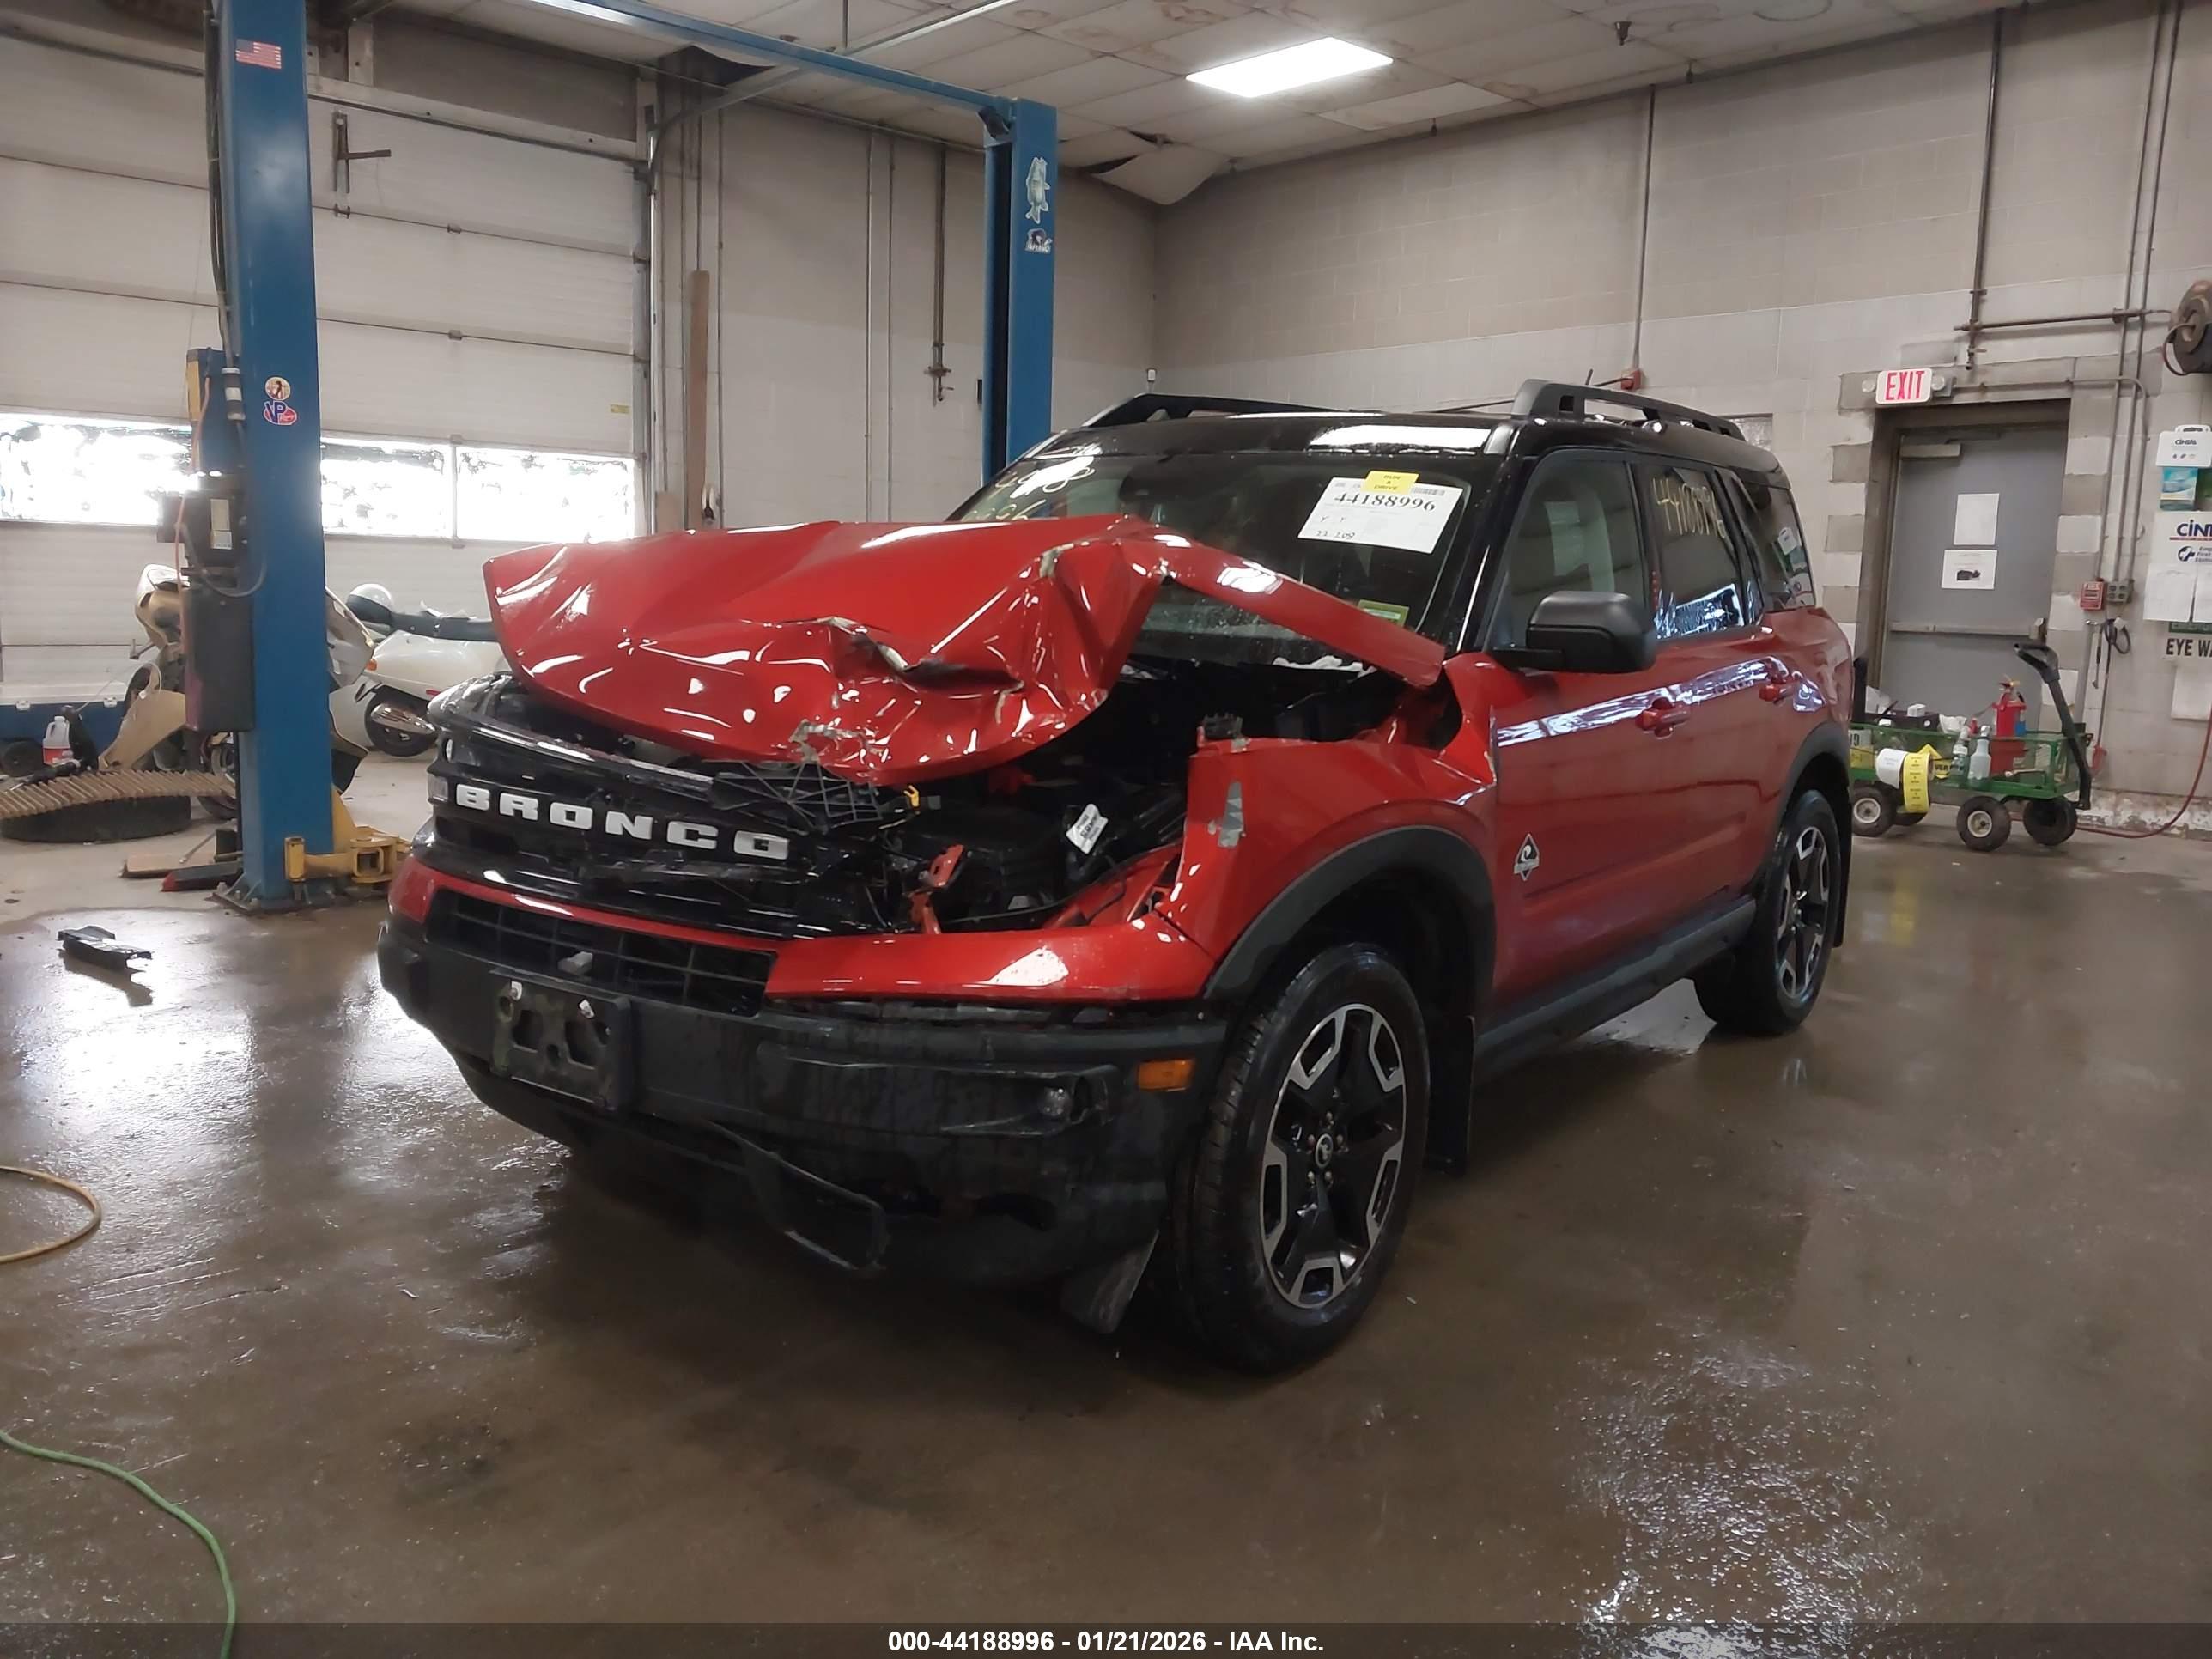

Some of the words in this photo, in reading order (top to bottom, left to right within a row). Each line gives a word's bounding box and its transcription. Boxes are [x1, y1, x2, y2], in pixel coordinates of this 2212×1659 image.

[1885, 371, 1925, 401] EXIT
[1334, 492, 1437, 512] 44188996
[2166, 638, 2193, 657] EYE
[456, 783, 789, 860] BRONCO
